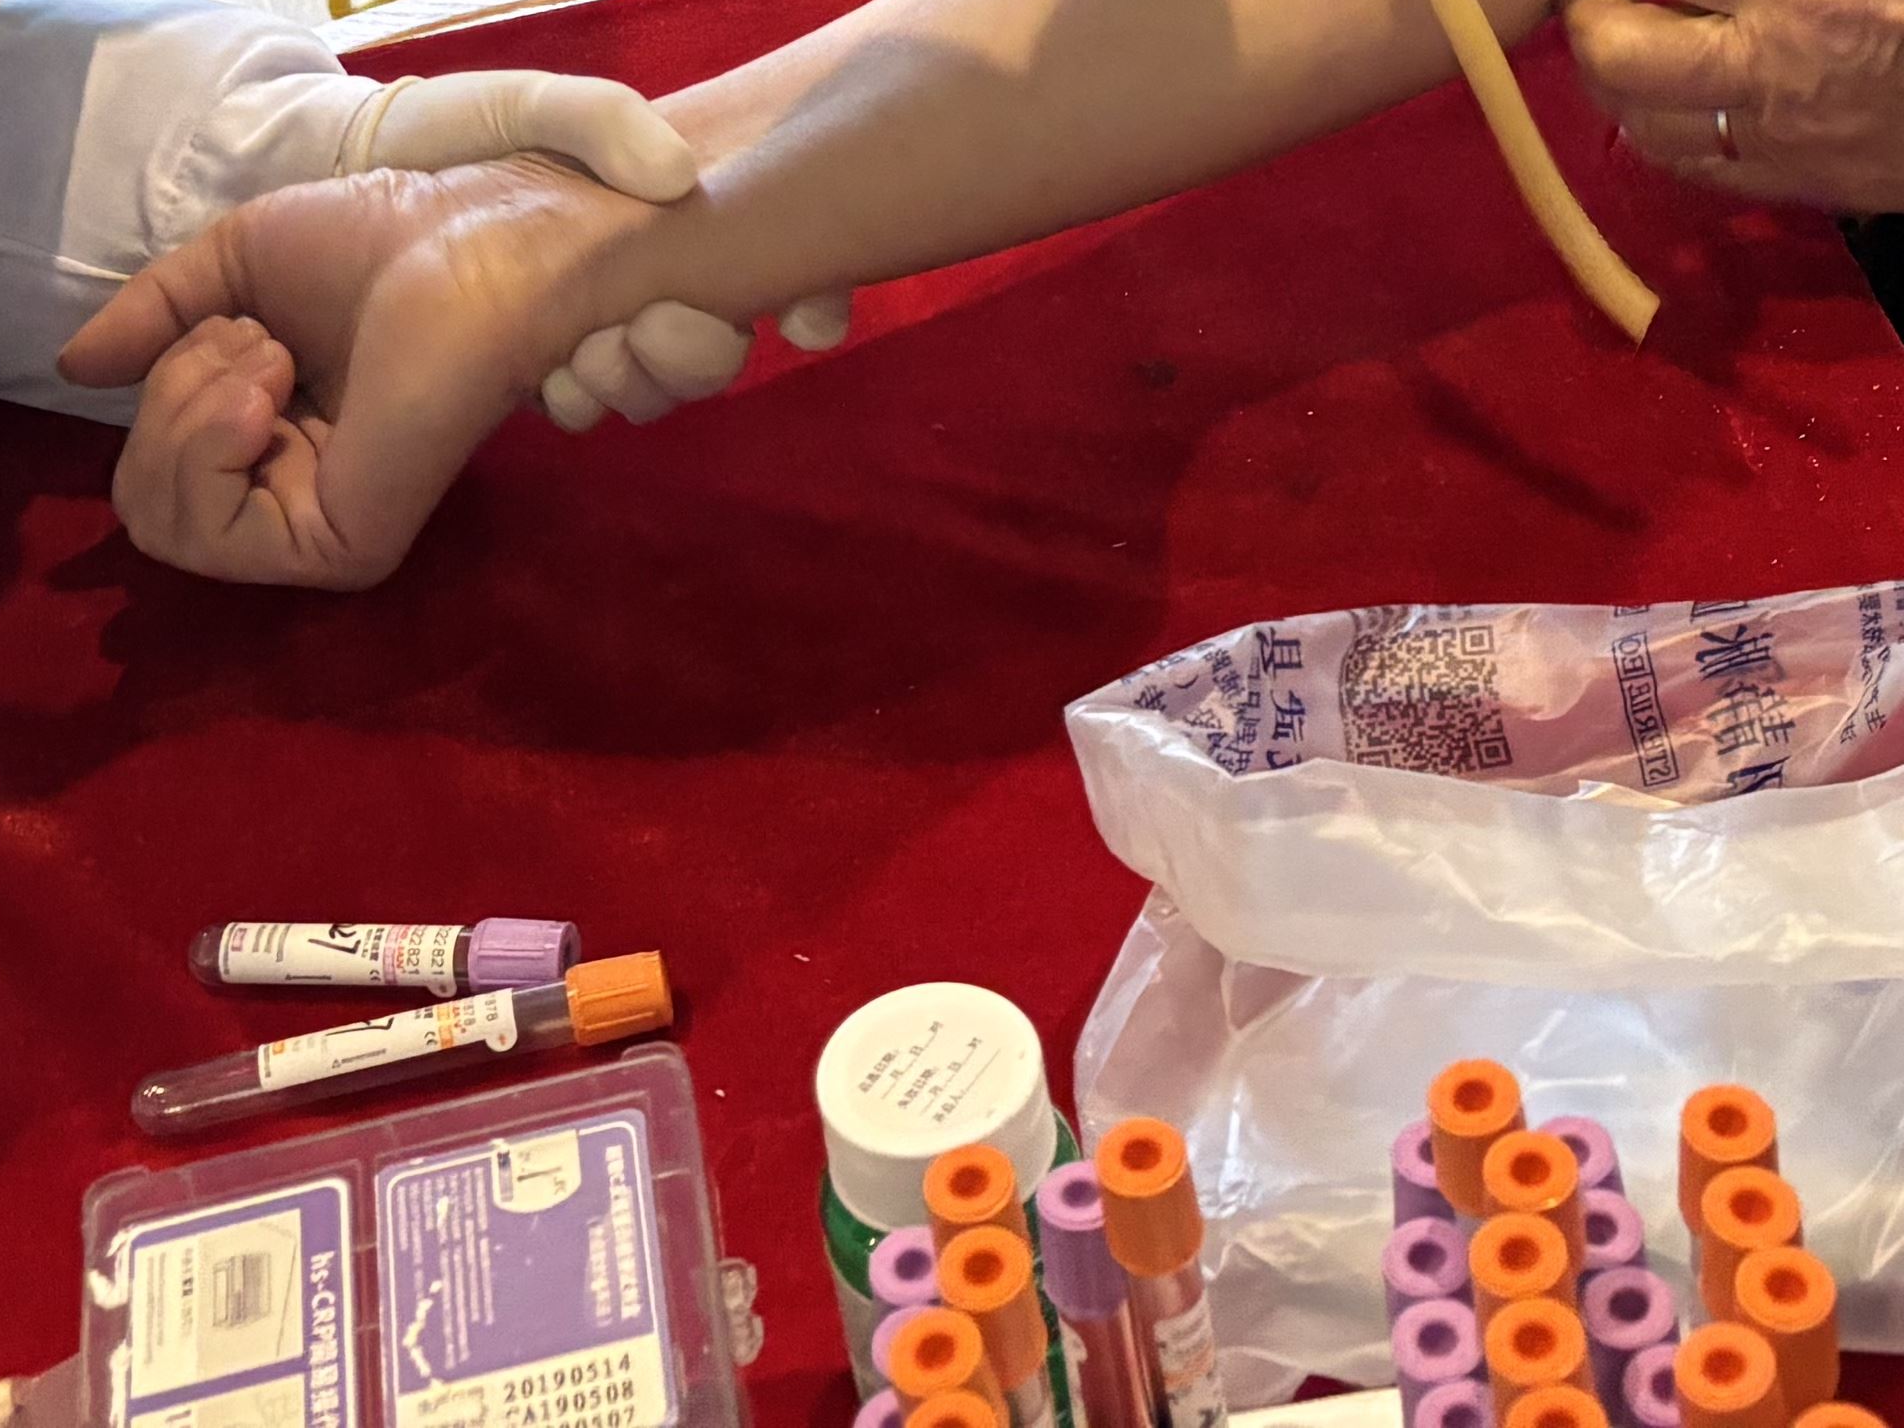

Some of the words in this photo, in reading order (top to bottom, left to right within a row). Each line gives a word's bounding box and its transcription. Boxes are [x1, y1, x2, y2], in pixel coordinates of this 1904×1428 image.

[406, 924, 425, 976] 22821
[430, 926, 452, 976] 22821
[503, 1352, 631, 1404] 20190514
